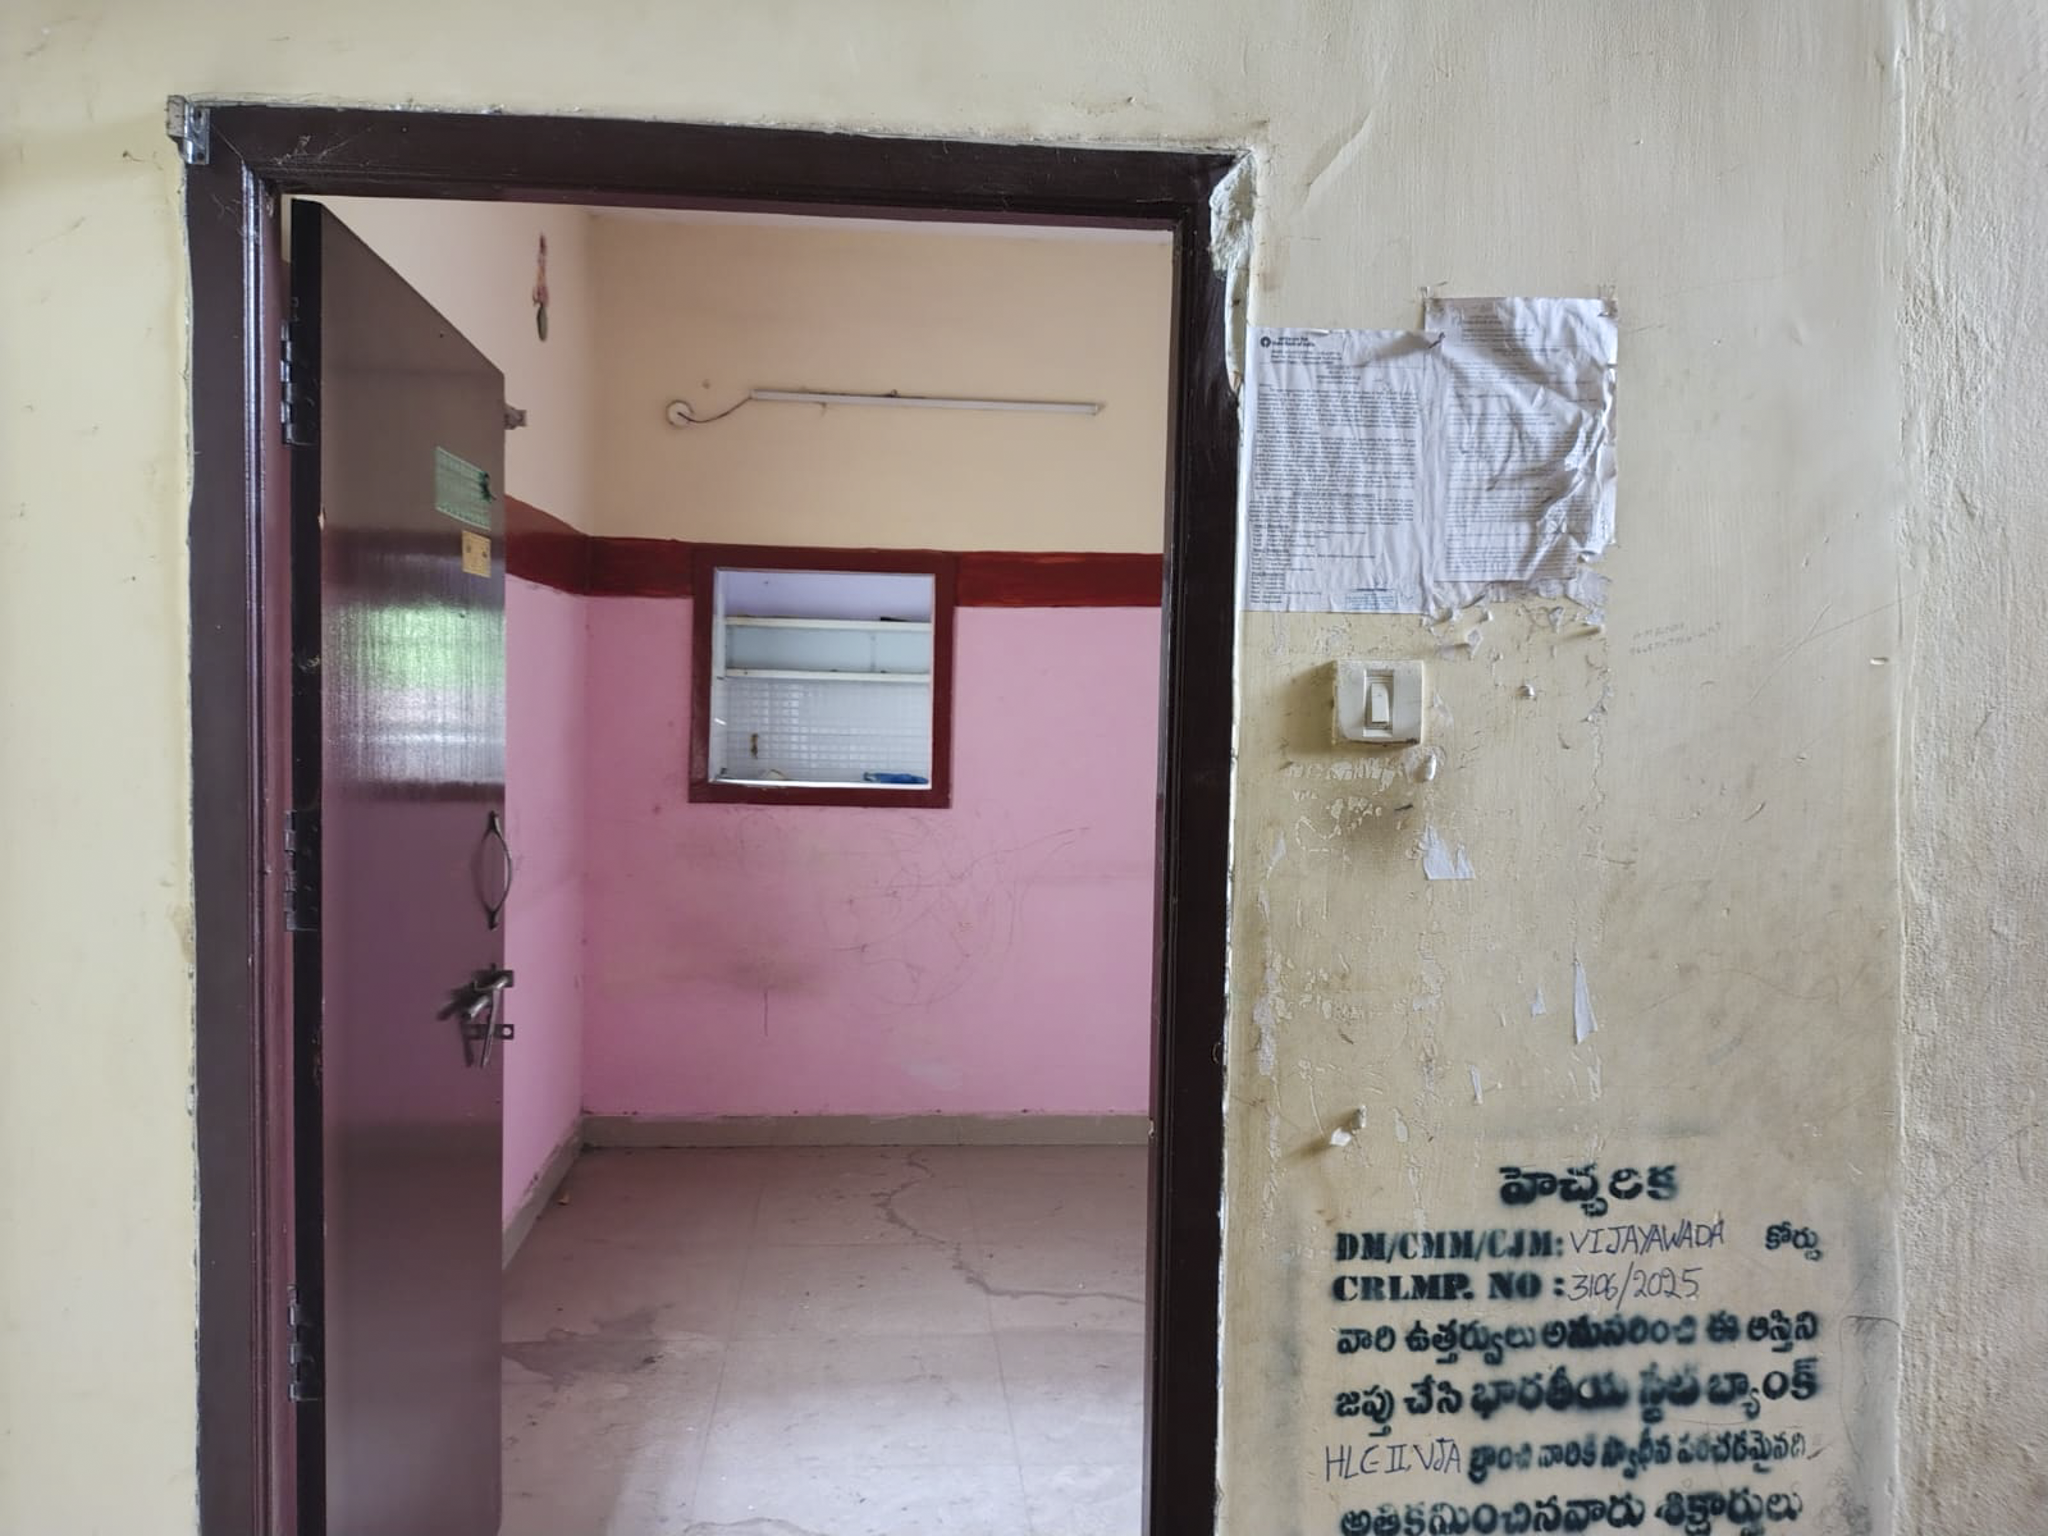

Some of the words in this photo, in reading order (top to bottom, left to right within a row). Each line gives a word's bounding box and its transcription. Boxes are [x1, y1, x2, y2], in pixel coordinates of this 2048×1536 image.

[1499, 1162, 1680, 1217] హెచ్చరిక
[1334, 1229, 1564, 1264] DM/CMM/CJM:
[1569, 1217, 1725, 1256] VIJAYAWADA
[1332, 1272, 1476, 1302] CRLMP.
[1488, 1270, 1543, 1300] NO
[1567, 1261, 1703, 1311] 3106/2025
[1336, 1325, 1396, 1354] వారి
[1405, 1319, 1537, 1366] ఉత్తర్వులు
[1335, 1384, 1396, 1437] జప్తు
[1403, 1373, 1463, 1415] చేసి
